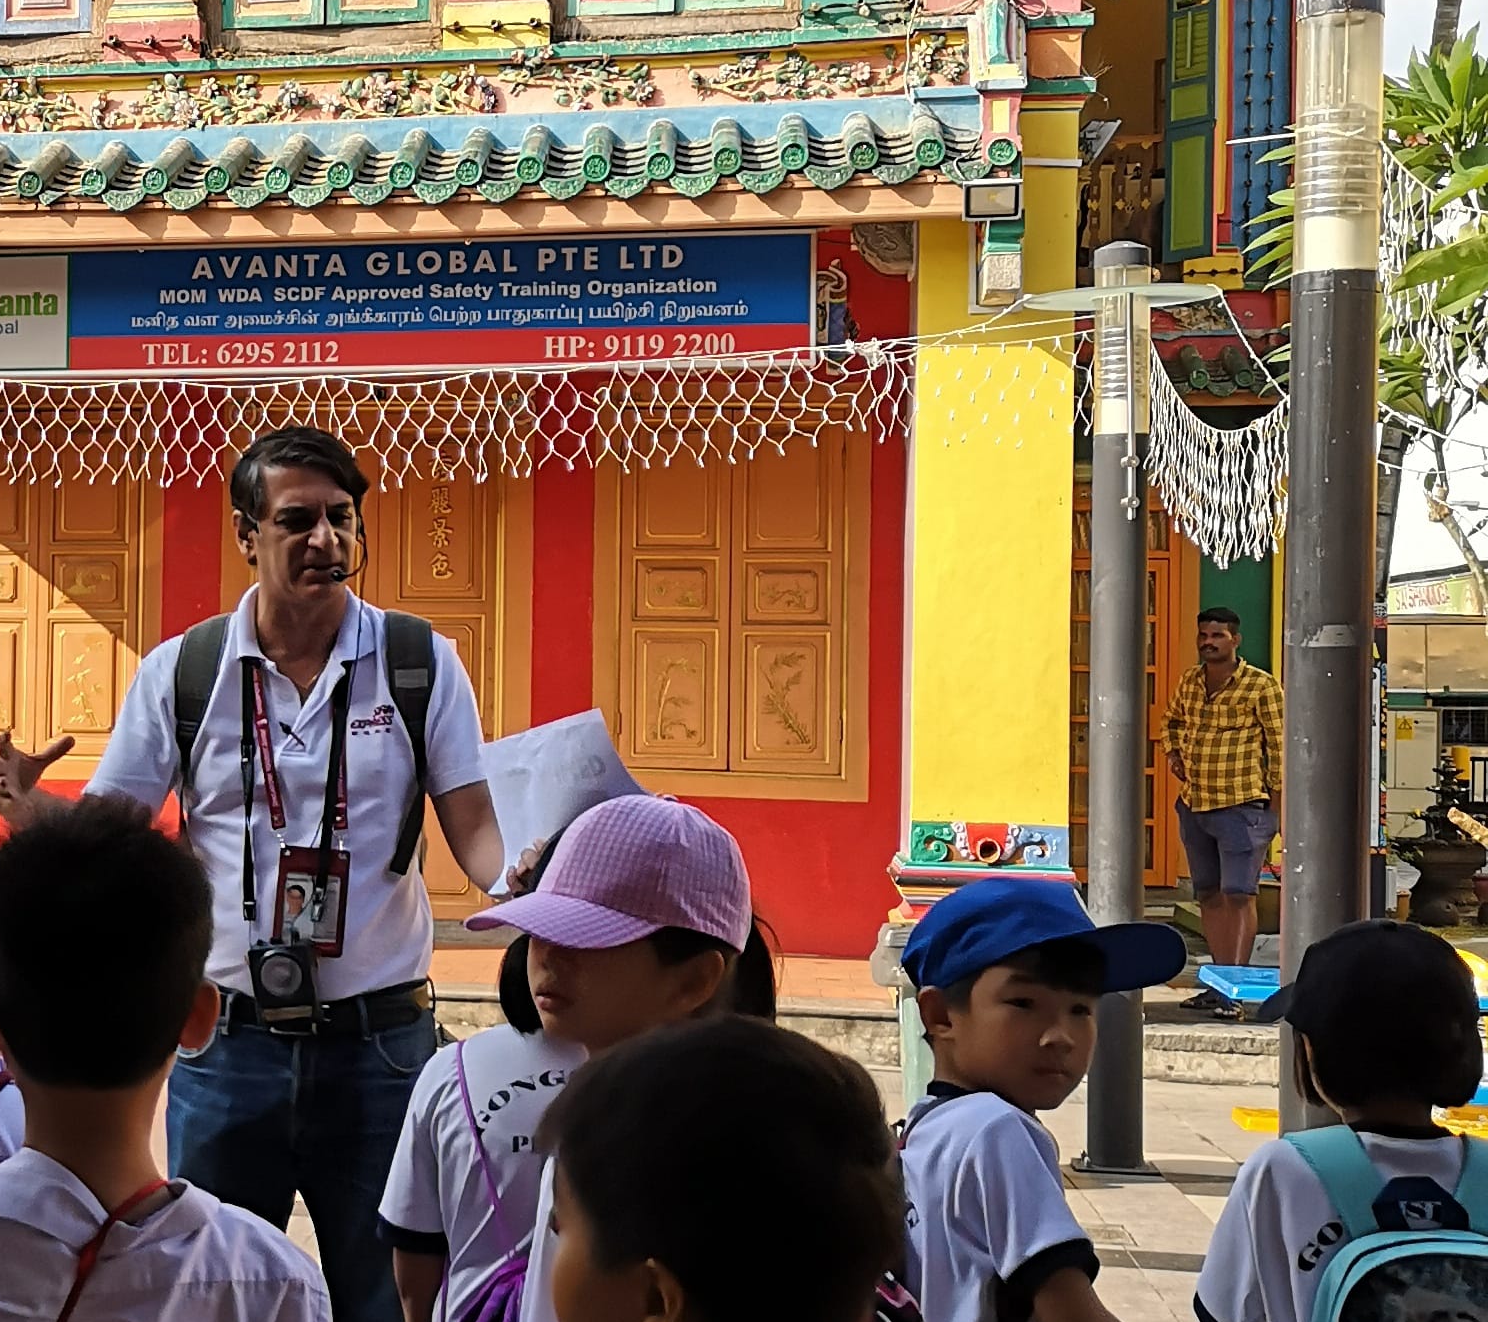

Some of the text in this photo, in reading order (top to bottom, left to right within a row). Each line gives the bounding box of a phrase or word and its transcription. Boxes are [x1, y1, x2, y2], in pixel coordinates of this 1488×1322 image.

[191, 244, 684, 279] AVANTA GLOBAL PTE LTD
[159, 278, 718, 304] MOM WDA SCDF Approved Safety Training Organization
[142, 340, 340, 365] TEL: 6295 2112
[543, 332, 736, 359] HP: 9119 2200
